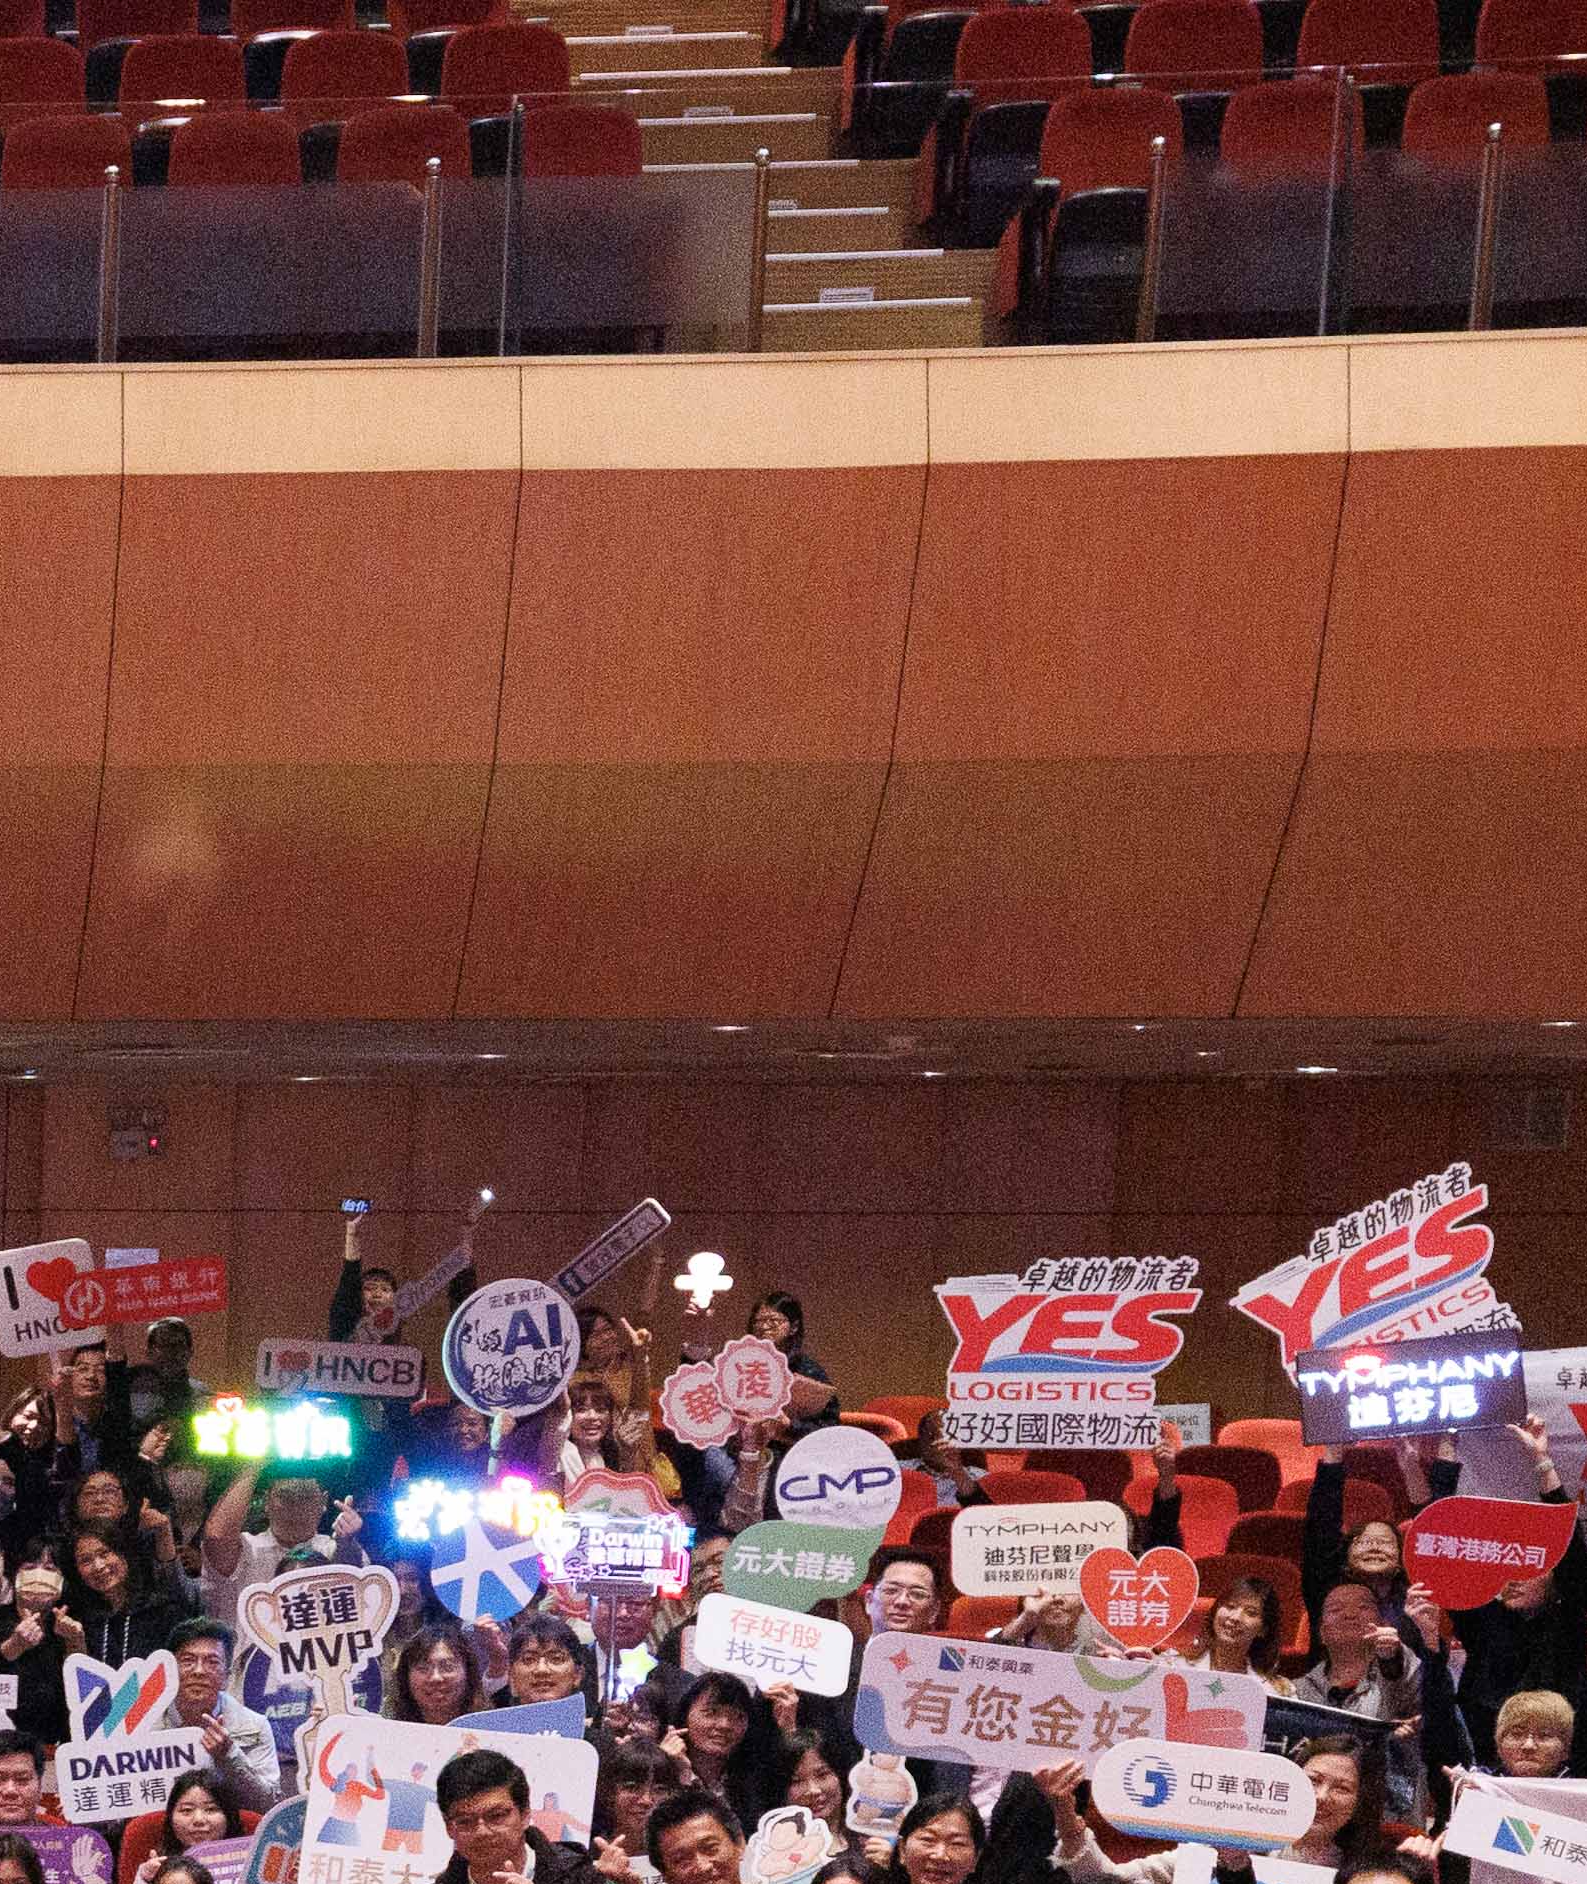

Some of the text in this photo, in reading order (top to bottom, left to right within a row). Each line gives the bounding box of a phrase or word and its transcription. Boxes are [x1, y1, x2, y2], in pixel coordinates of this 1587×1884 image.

[1310, 1162, 1469, 1264] 卓越的物流者
[1024, 1259, 1194, 1293] 卓越的物流者
[1238, 1182, 1491, 1369] YES
[504, 1303, 565, 1356] AI
[940, 1288, 1202, 1374] YES
[316, 1356, 415, 1385] HNCB
[736, 1360, 774, 1400] 凌
[949, 1380, 1153, 1403] LOGISTICS
[944, 1411, 1158, 1446] 好好國際物流
[780, 1469, 896, 1502] CMP
[589, 1529, 662, 1547] Darwin
[963, 1520, 1116, 1538] TYMPHANY
[734, 1545, 855, 1584] 元大證券
[1415, 1532, 1547, 1569] 臺灣港務公司
[1108, 1568, 1169, 1598] 元大
[281, 1585, 359, 1631] 達運
[1108, 1598, 1172, 1627] 證券
[729, 1609, 821, 1650] 存好股
[280, 1628, 373, 1675] MVP
[725, 1639, 818, 1680] 找元大
[969, 1655, 1034, 1676] 和泰興業
[904, 1679, 1149, 1751] 有您金好
[70, 1743, 195, 1781] DARWIN
[1191, 1771, 1289, 1802] 中華電信
[1189, 1796, 1287, 1817] Chunghwa Telecom
